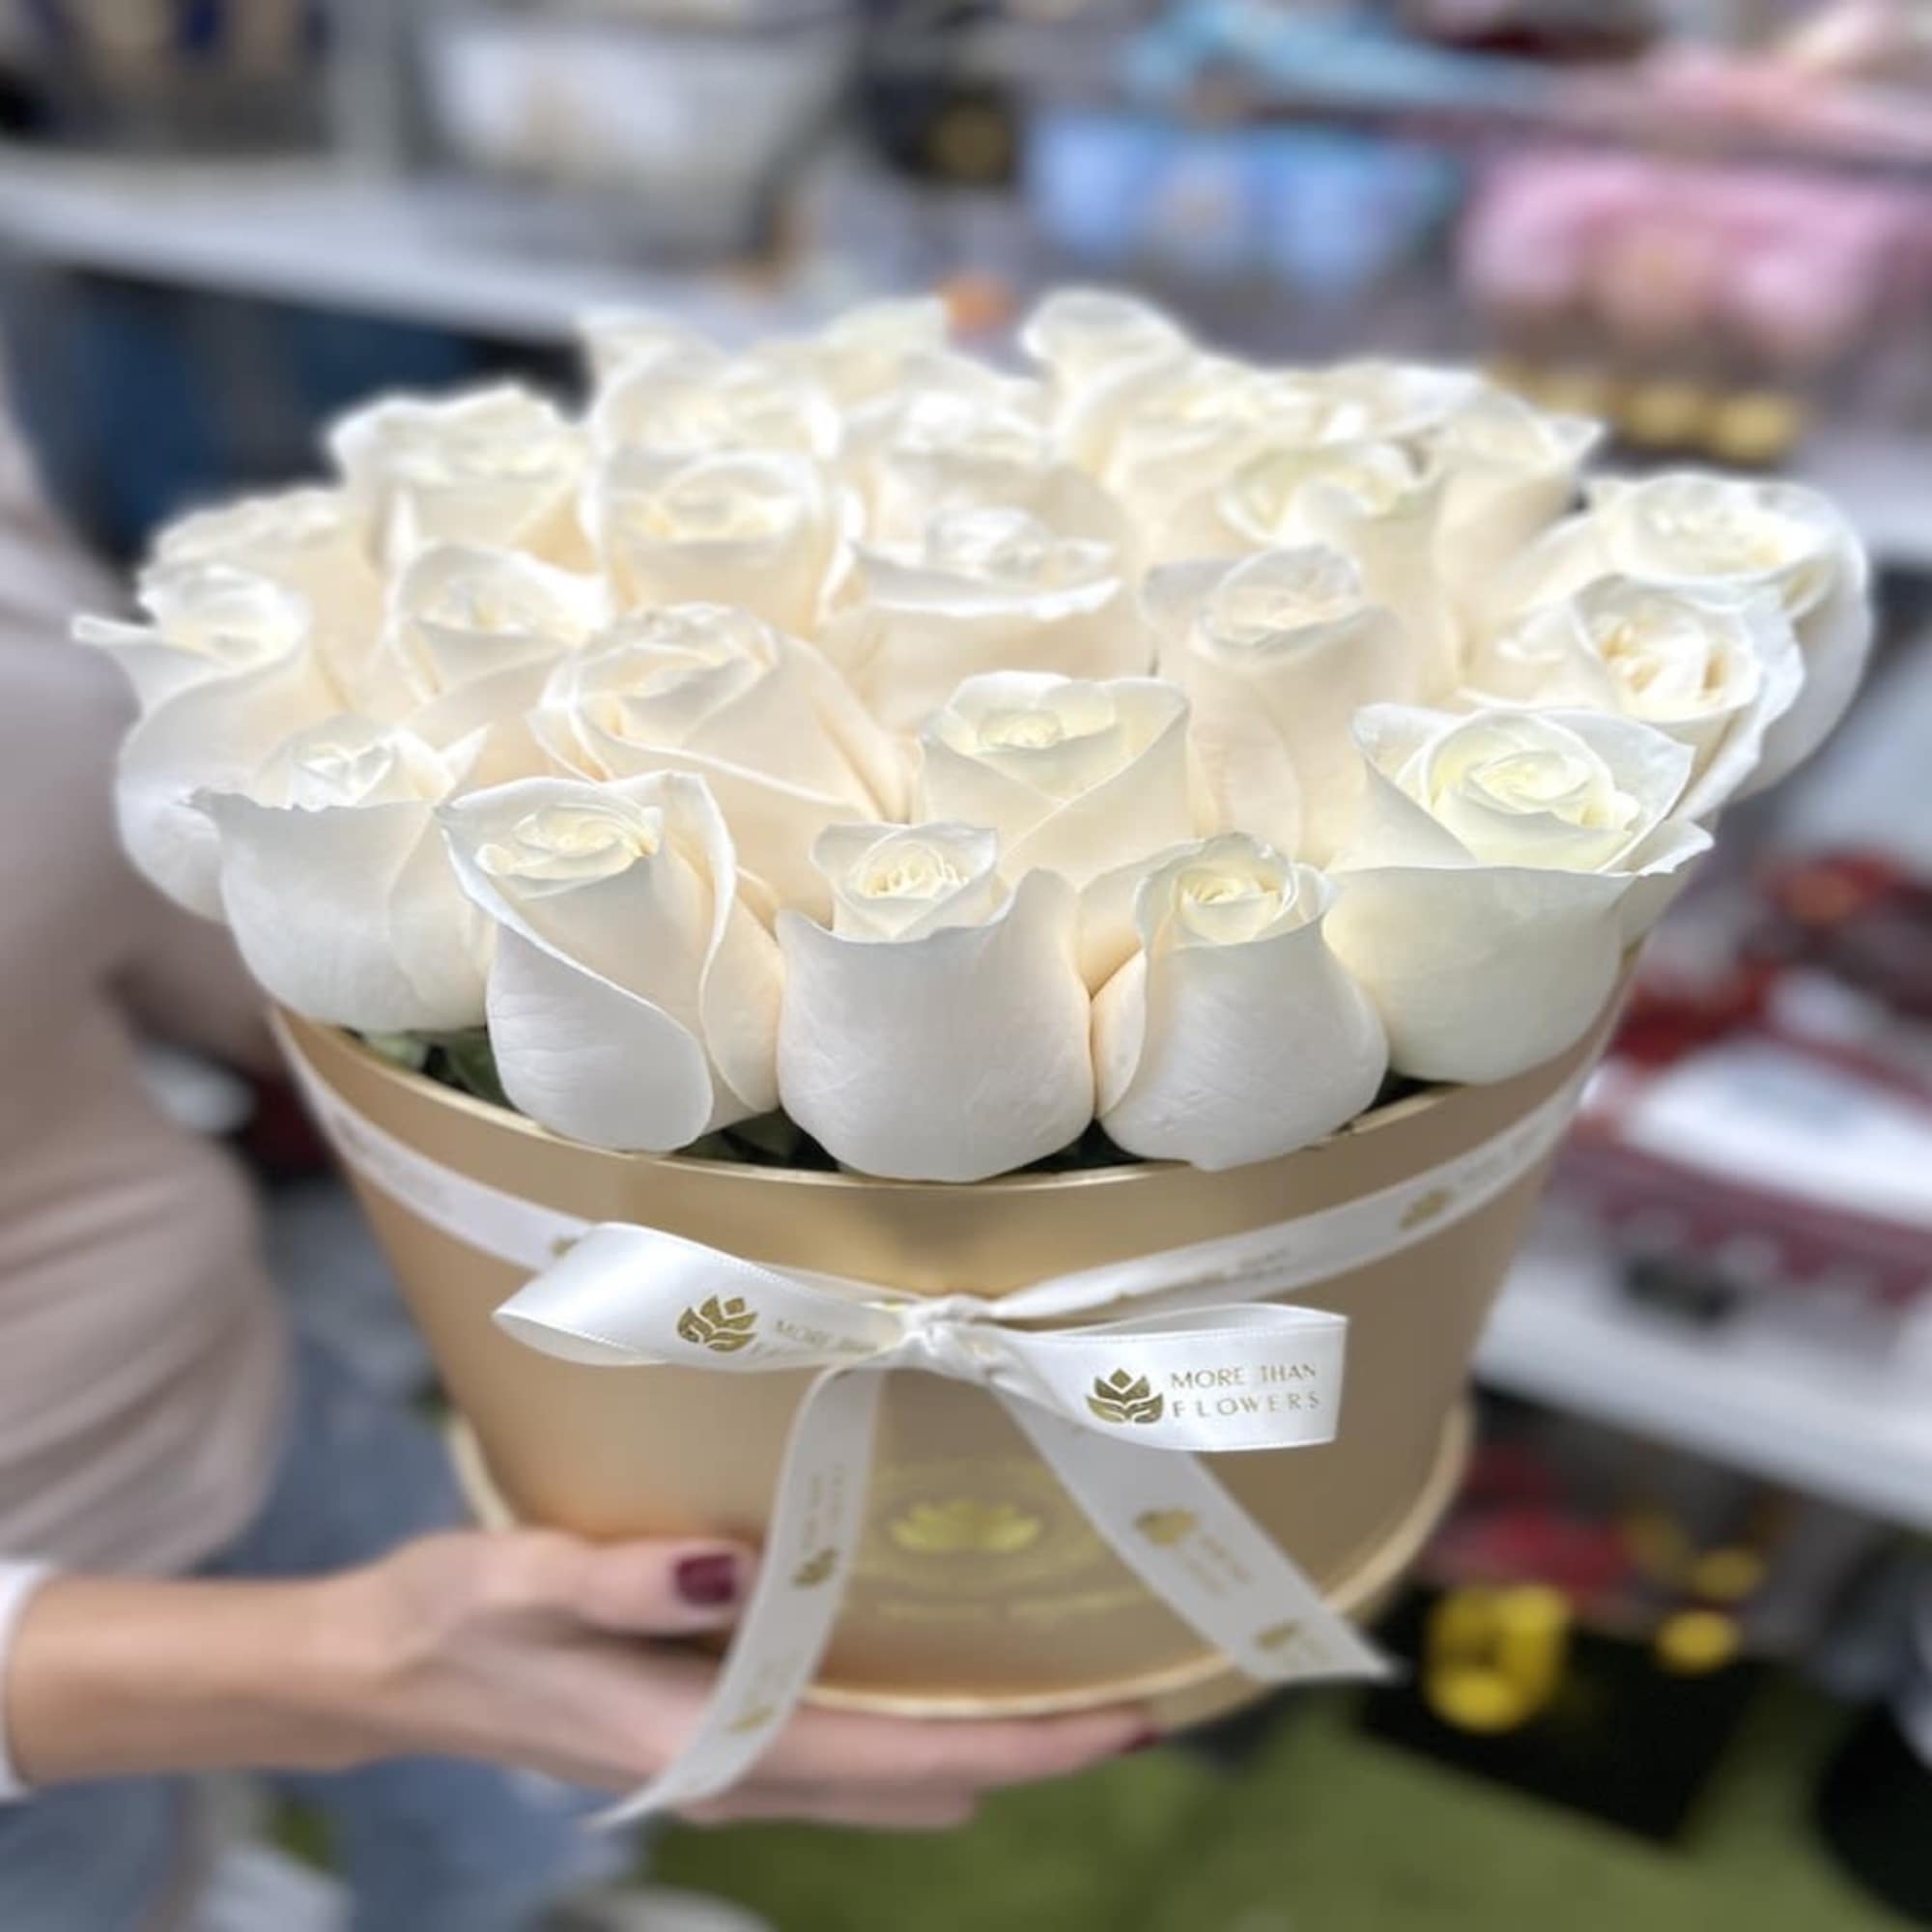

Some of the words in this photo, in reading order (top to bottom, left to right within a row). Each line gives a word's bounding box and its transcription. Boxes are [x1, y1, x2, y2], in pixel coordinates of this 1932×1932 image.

[1170, 1367, 1245, 1389] MORE
[1260, 1362, 1317, 1382] THAN
[1173, 1391, 1320, 1417] FLOWERS
